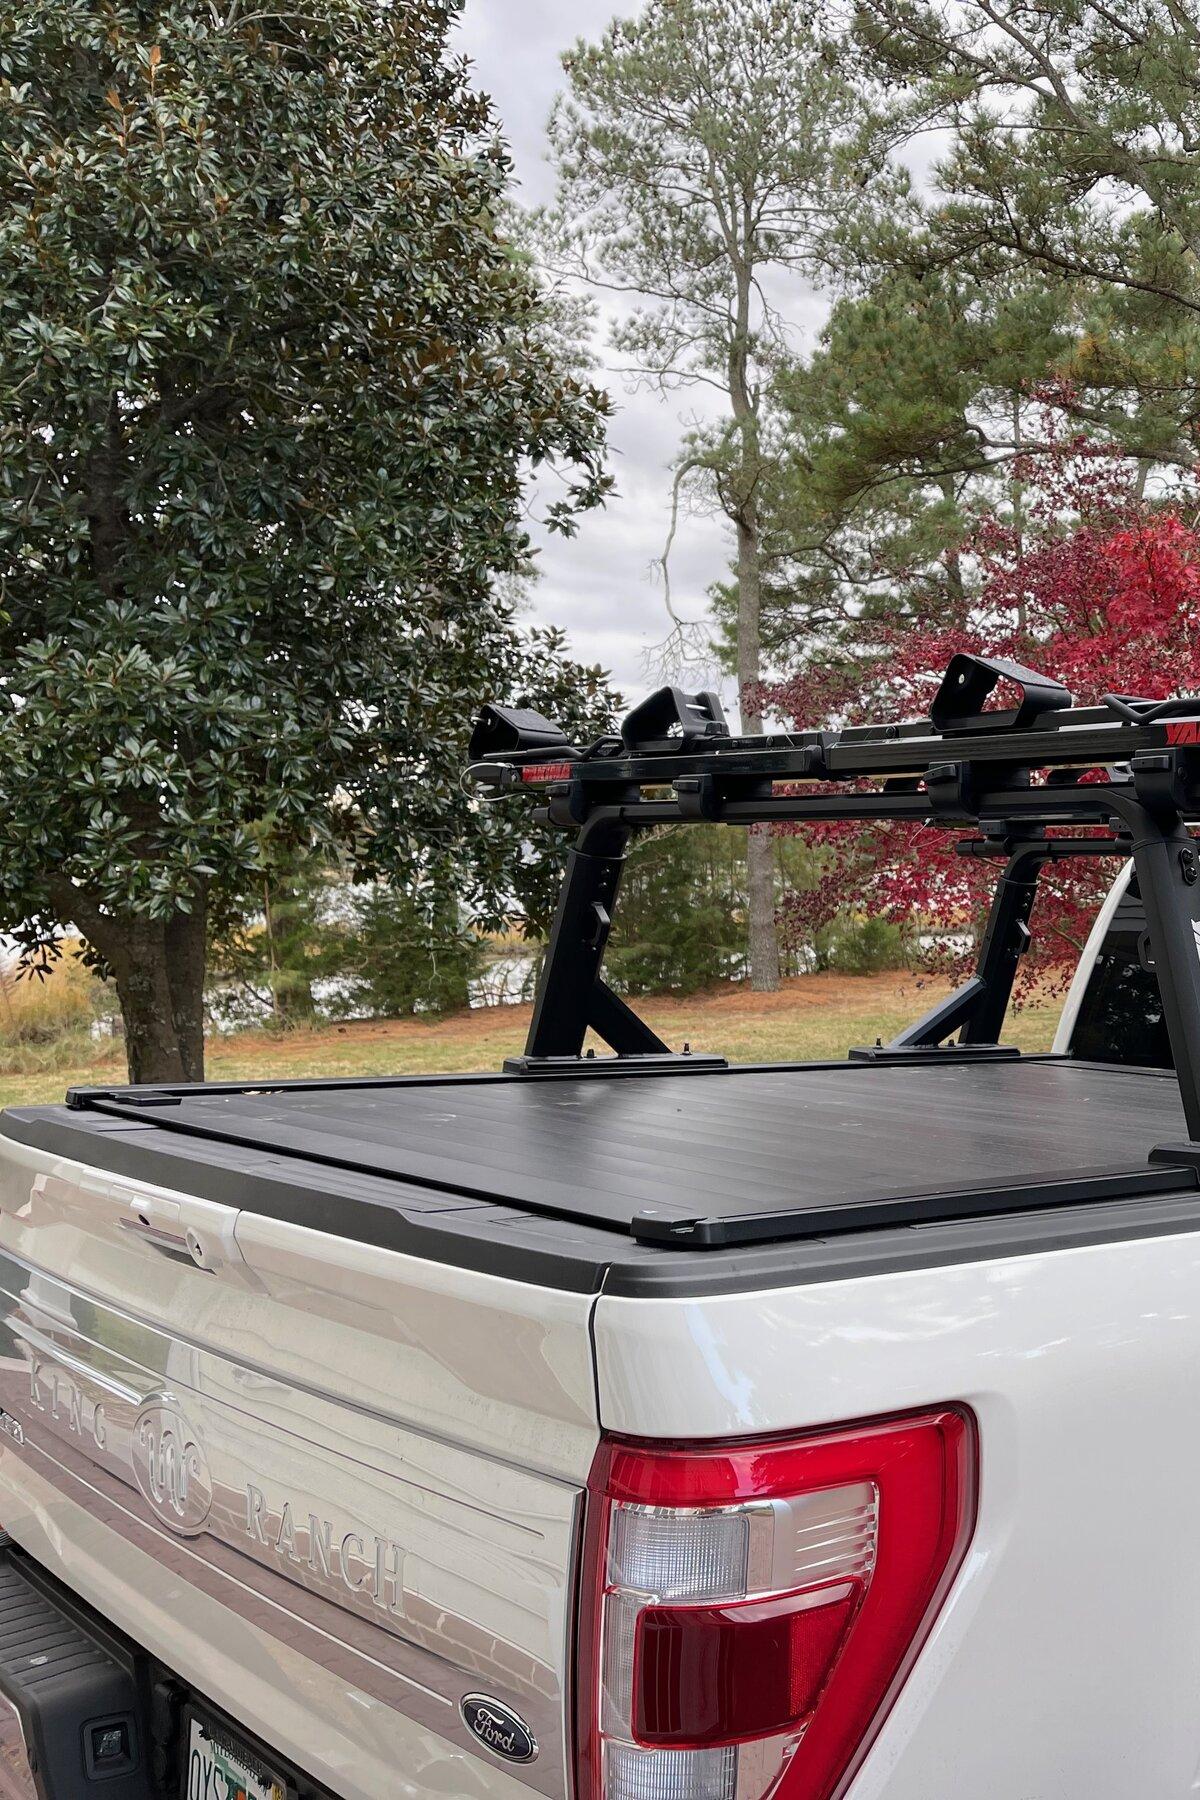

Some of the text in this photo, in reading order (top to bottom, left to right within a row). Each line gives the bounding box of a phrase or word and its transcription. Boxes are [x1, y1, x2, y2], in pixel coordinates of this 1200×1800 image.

[29, 1359, 407, 1618] KING RANCH
[474, 1708, 516, 1752] Ford
